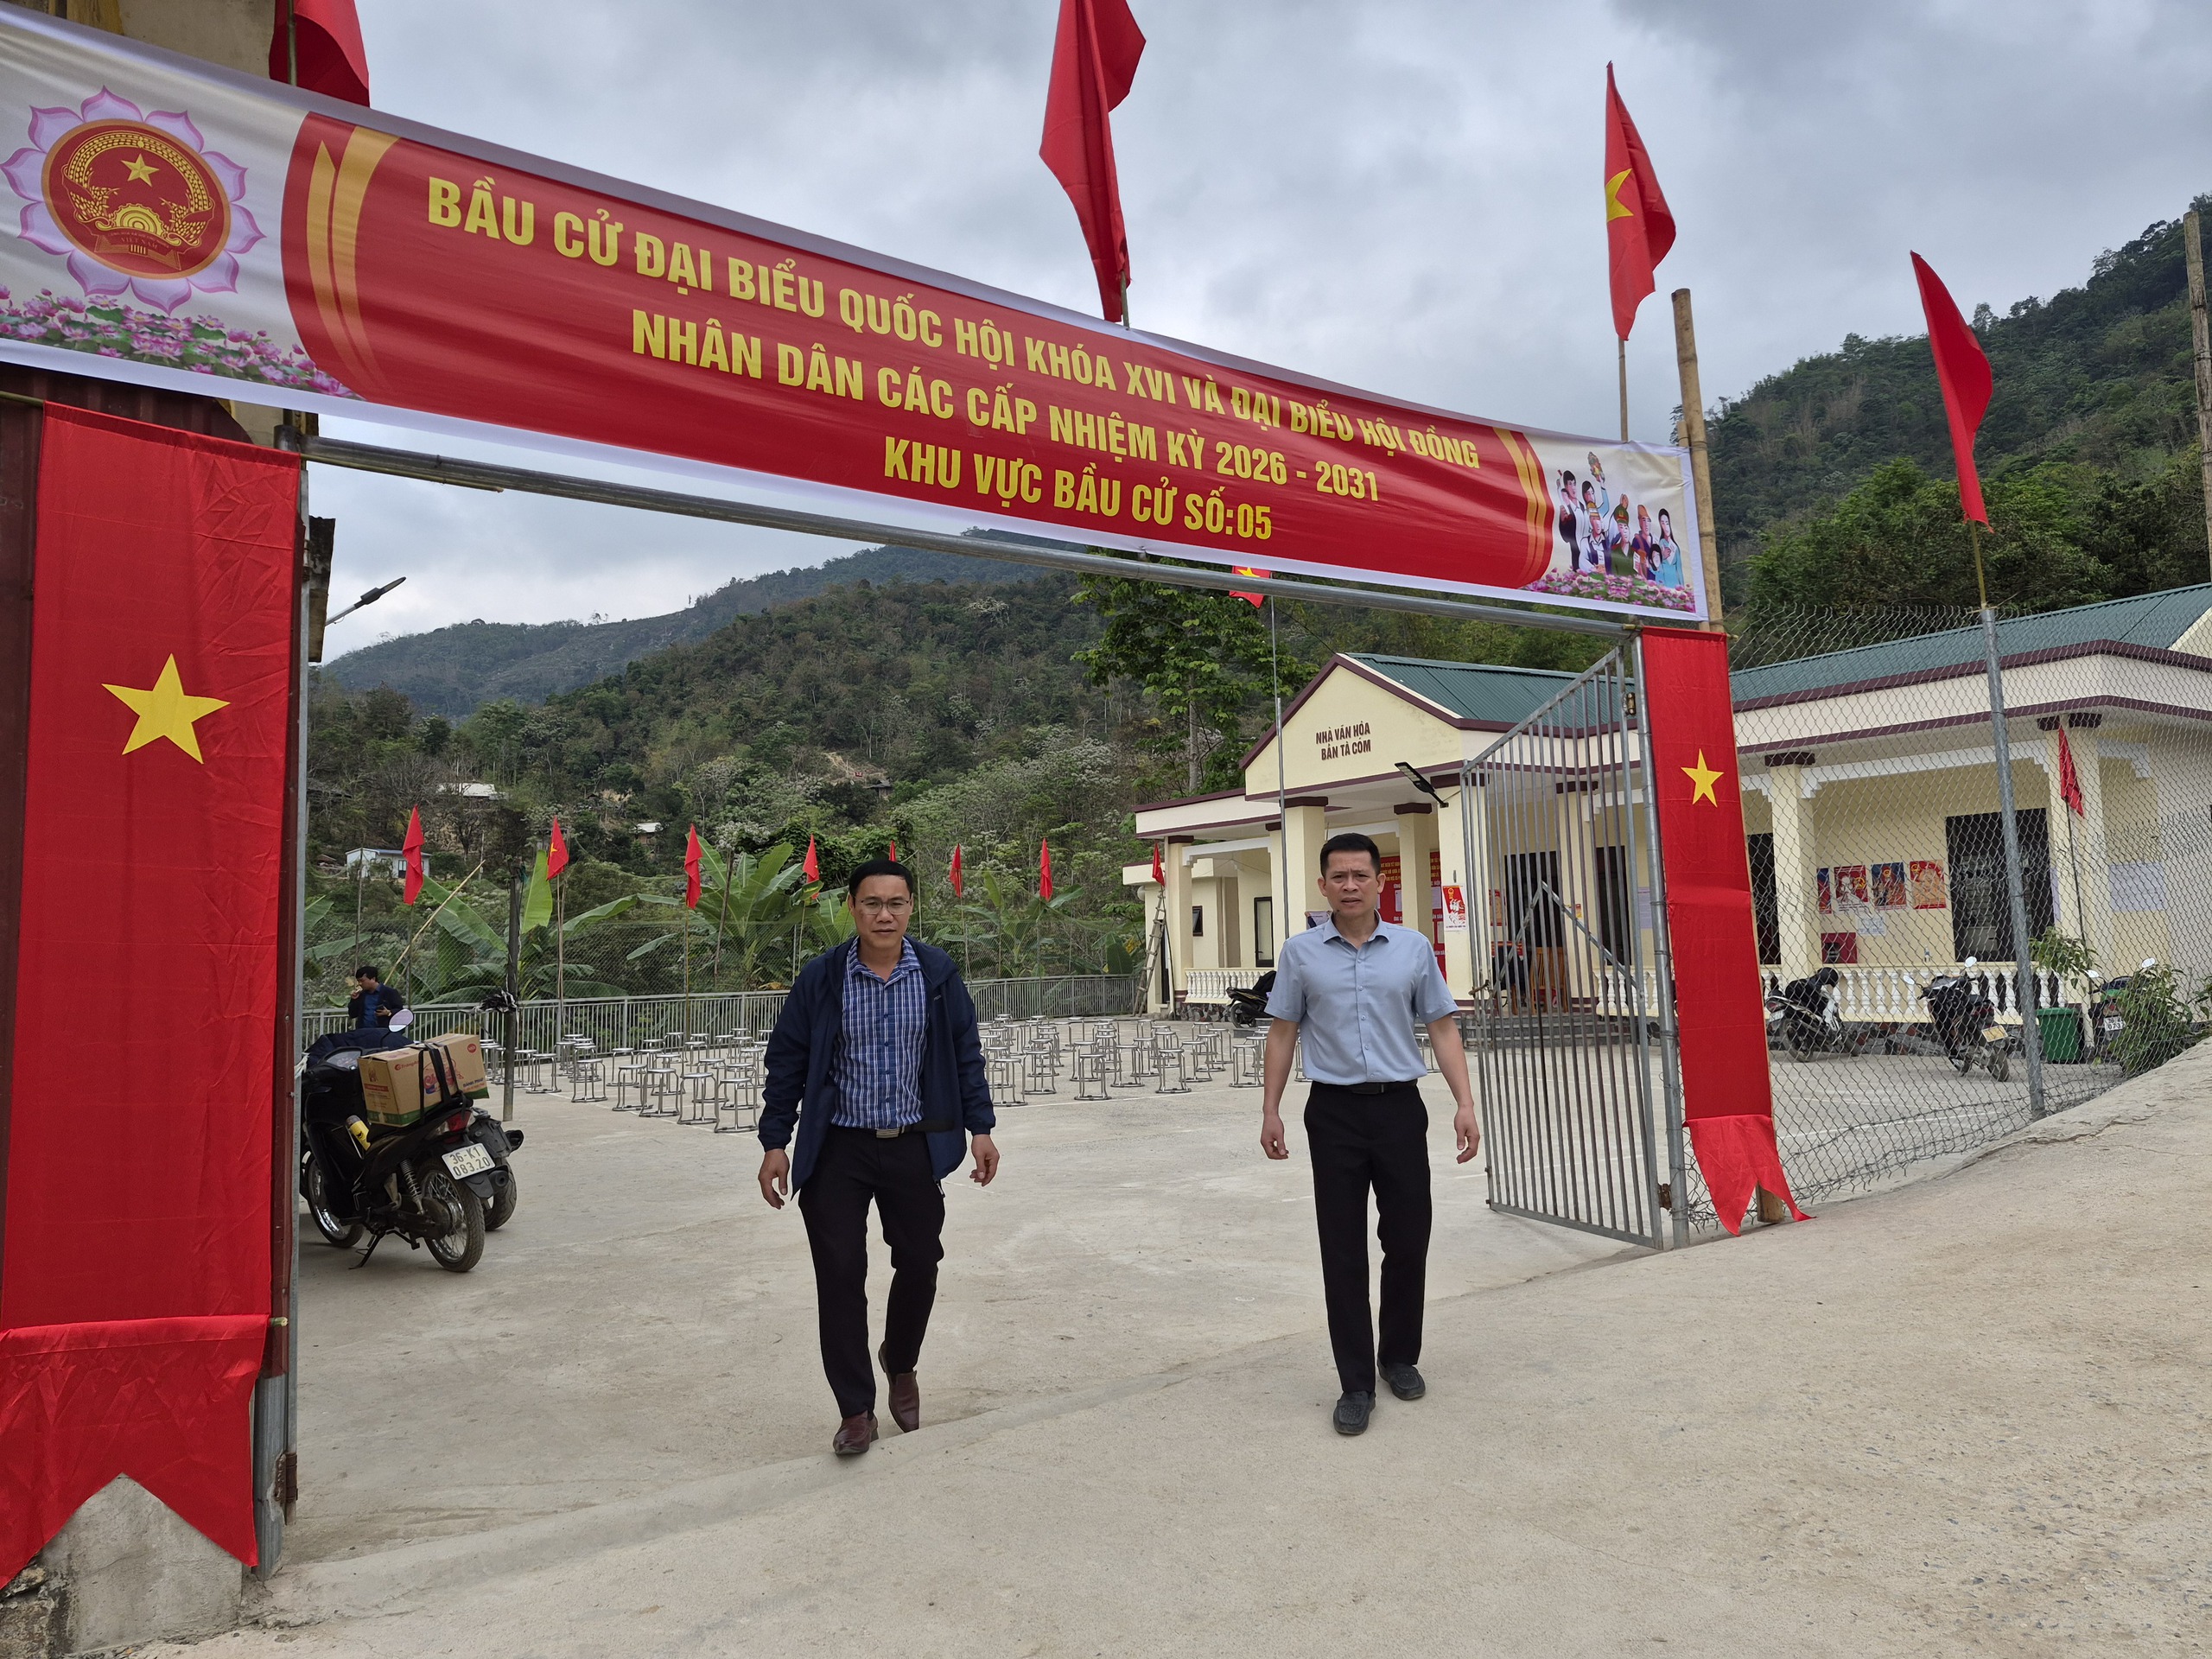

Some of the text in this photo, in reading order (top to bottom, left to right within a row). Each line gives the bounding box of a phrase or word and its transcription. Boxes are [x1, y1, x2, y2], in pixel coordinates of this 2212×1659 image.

[429, 175, 1479, 468] BẦU CỬ ĐẠI BIỂU QUỐC HỘI KHÓA XVI VÀ ĐẠI BIỂU HỘI ĐỒNG
[633, 309, 761, 378] NHÂN
[779, 343, 863, 400] DÂN
[878, 366, 953, 418] CÁC
[968, 383, 1037, 435] CẤP
[1050, 406, 1157, 462] NHIỆM
[1167, 429, 1205, 469] KỲ
[1217, 442, 1287, 485] 2026
[1316, 461, 1379, 501] 2031
[885, 436, 1271, 539] KHU VỰC BẦU CỬ SỐ:05
[1316, 727, 1333, 744] NHÀ
[1321, 743, 1338, 760] BẢN
[1340, 741, 1351, 757] TÀ
[449, 1147, 480, 1165] 36-K1
[453, 1157, 491, 1176] 083.20
